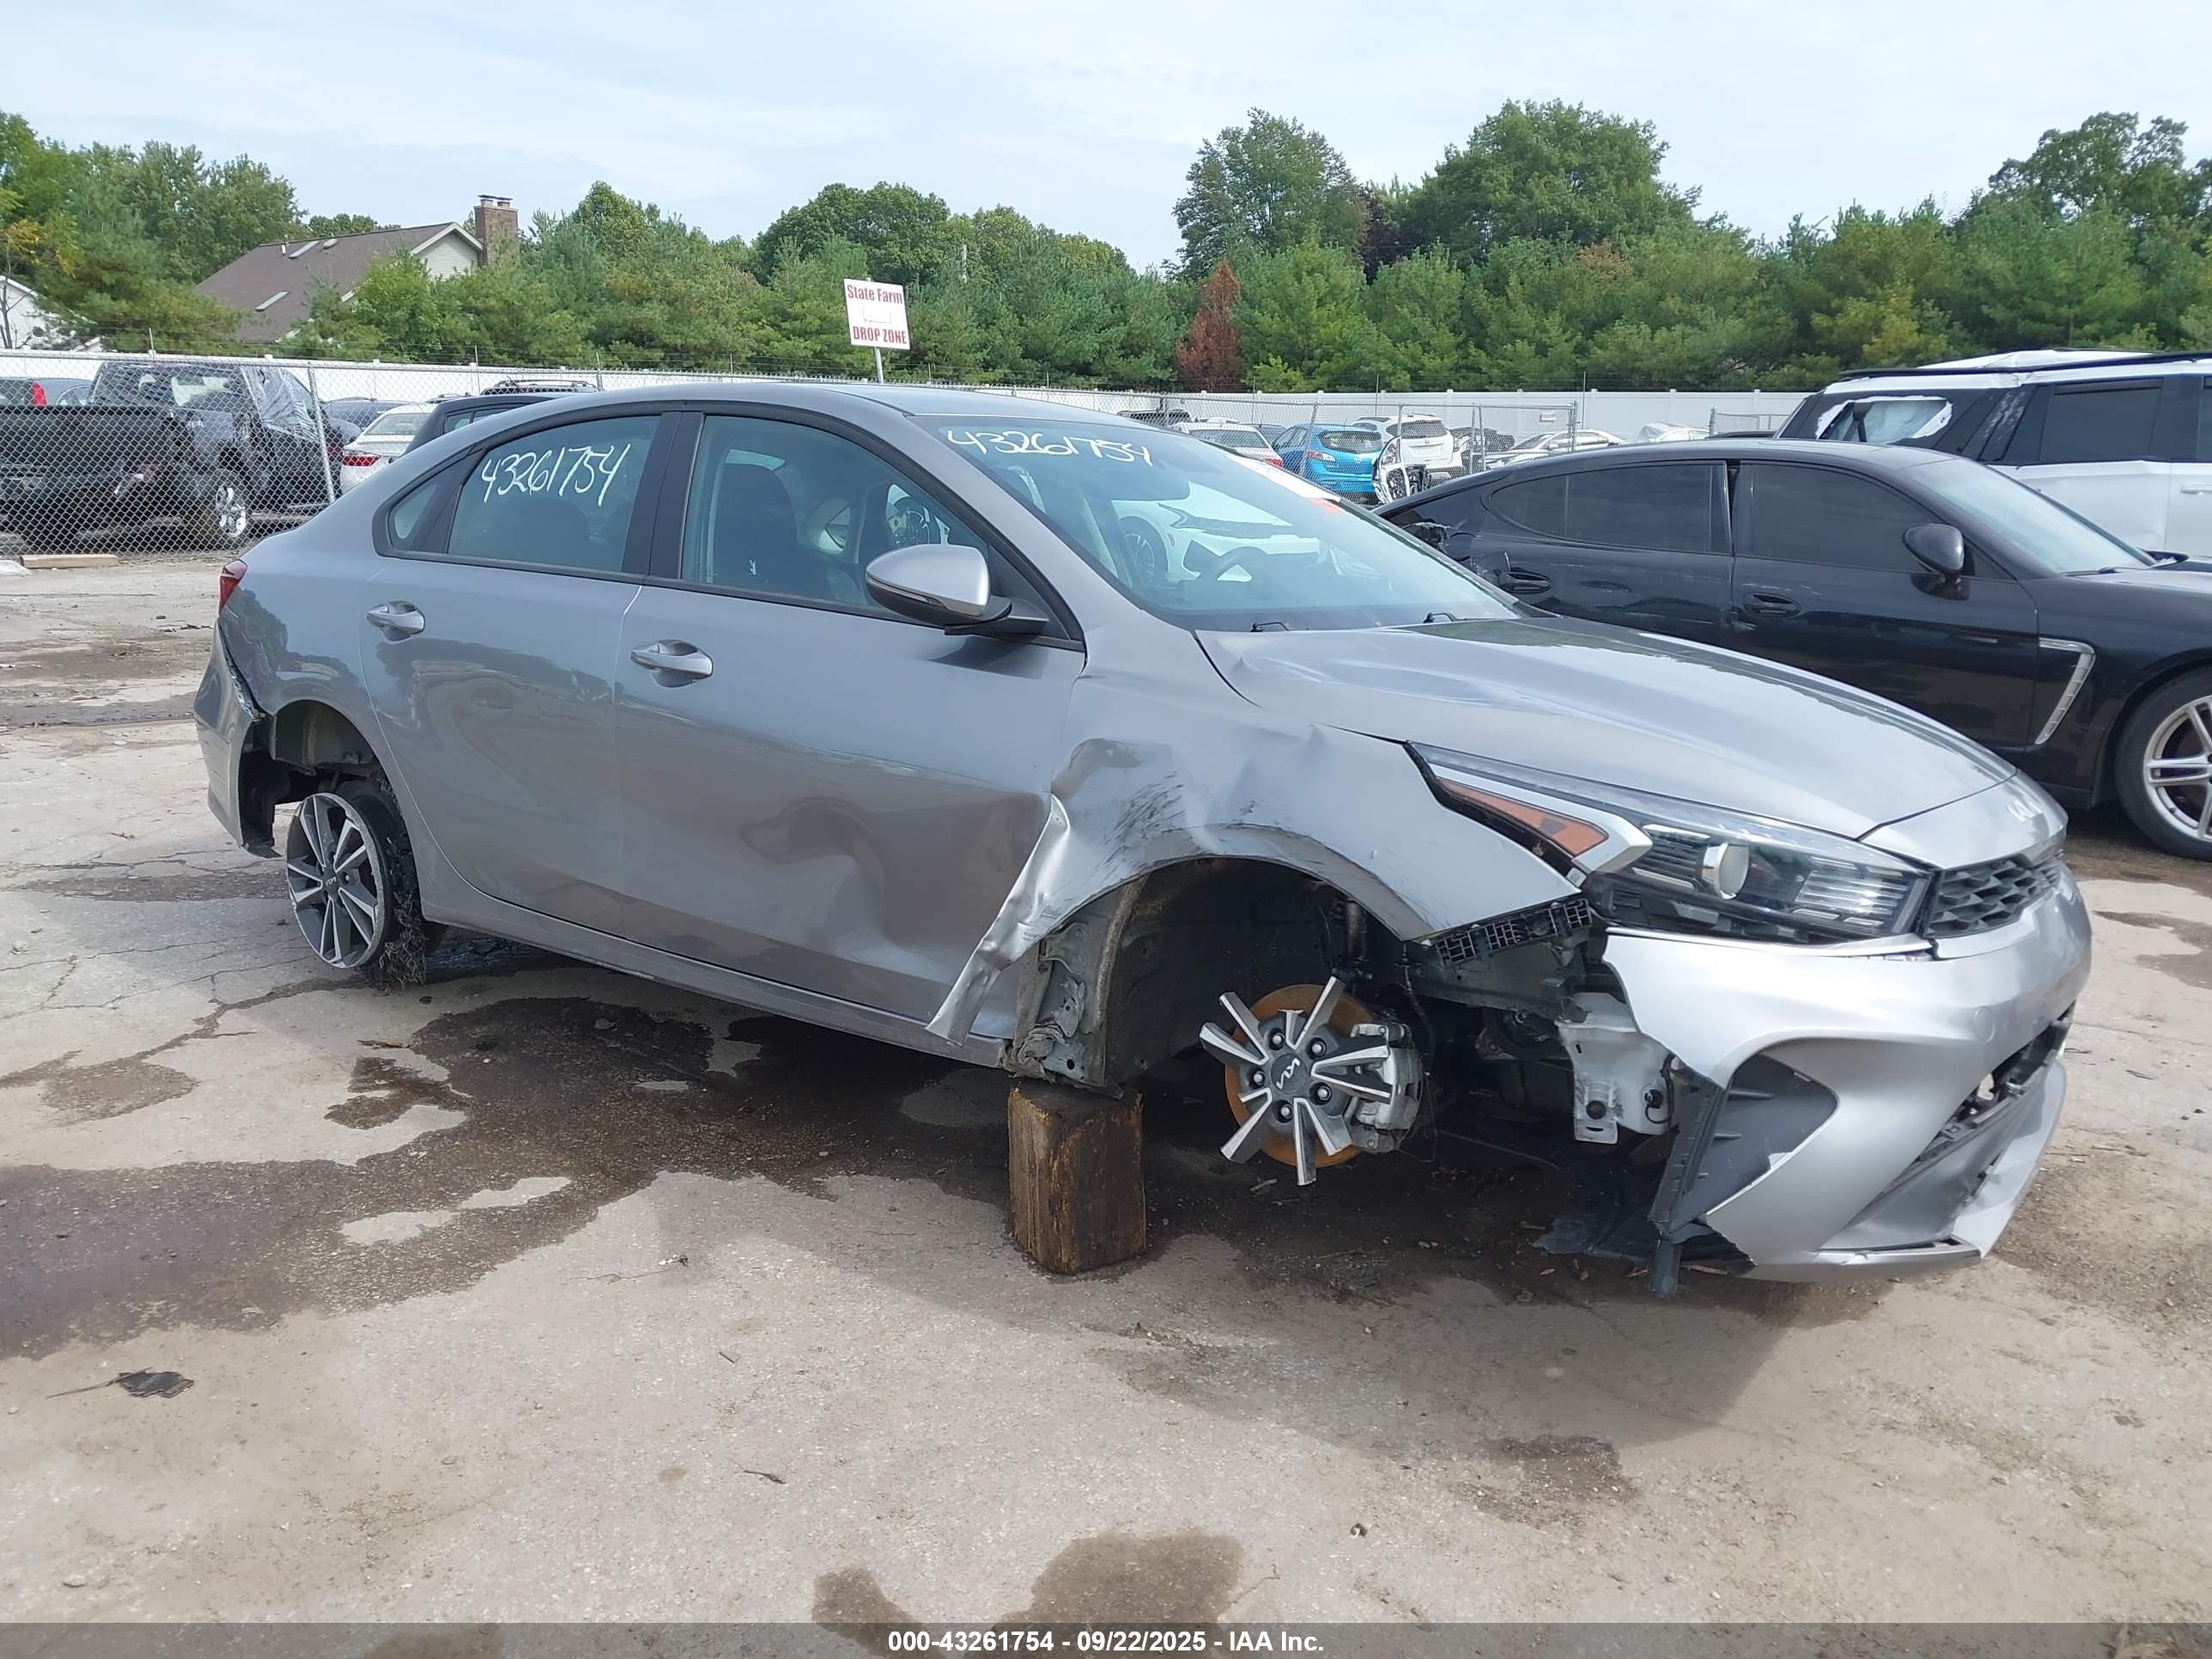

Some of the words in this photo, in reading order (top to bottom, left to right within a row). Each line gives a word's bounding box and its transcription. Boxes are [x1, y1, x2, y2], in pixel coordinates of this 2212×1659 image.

[847, 284, 875, 301] State
[877, 288, 902, 304] Farm
[853, 325, 880, 342] DROP
[882, 328, 908, 343] ZONE
[947, 429, 1153, 467] 43261754
[482, 442, 631, 507] 43261754
